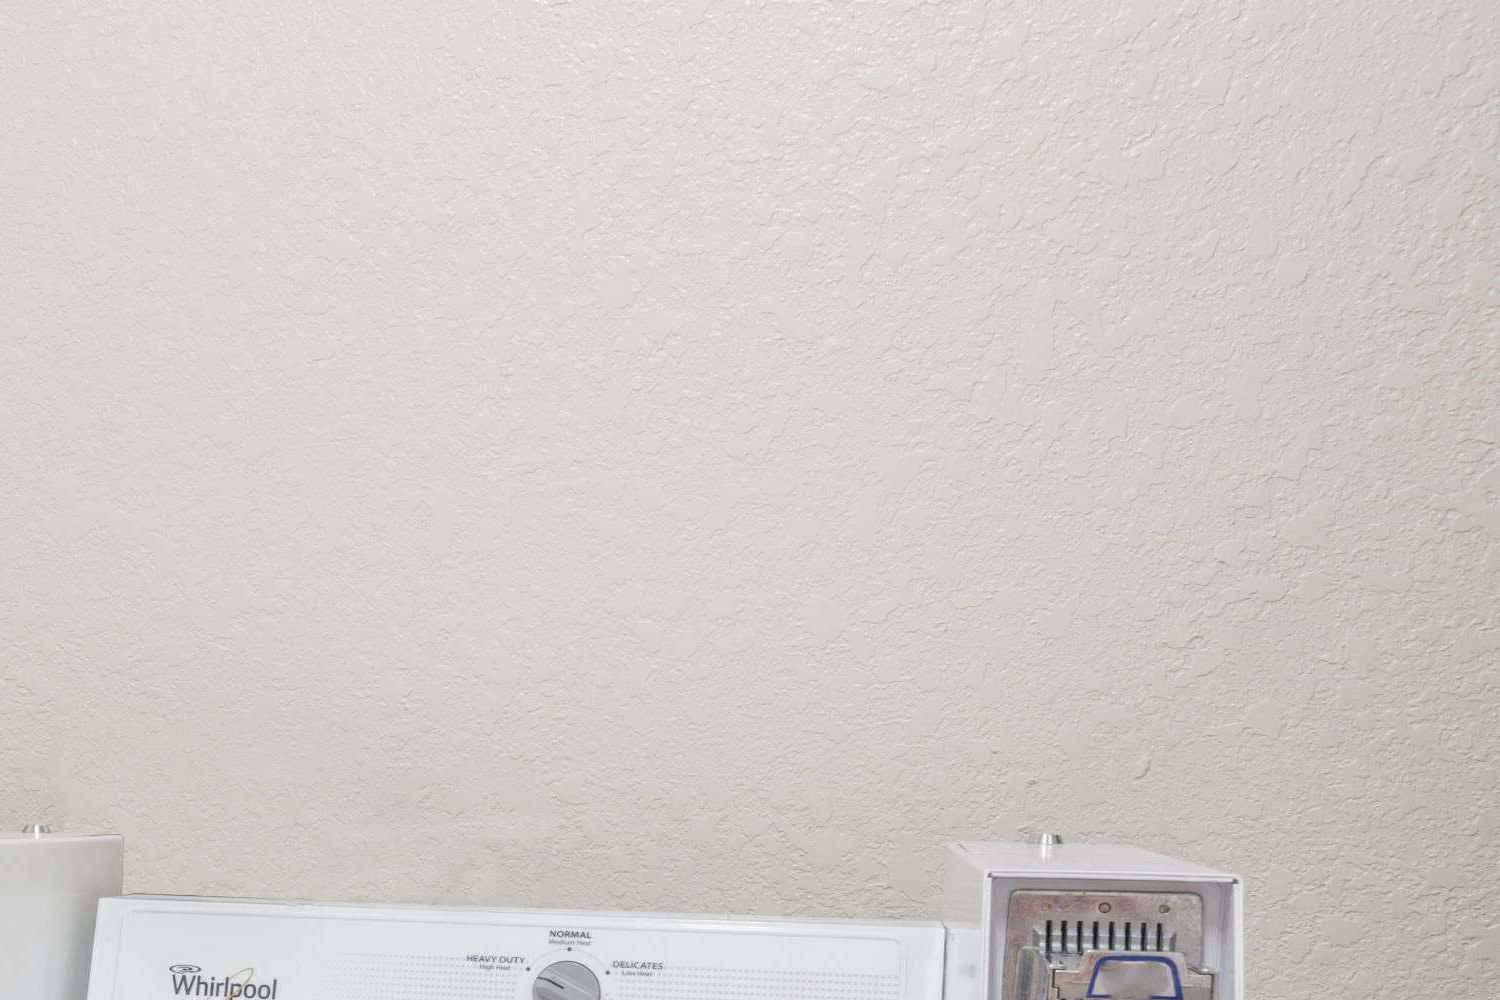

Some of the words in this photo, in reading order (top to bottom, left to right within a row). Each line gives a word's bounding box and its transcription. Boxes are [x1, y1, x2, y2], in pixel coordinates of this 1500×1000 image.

[549, 930, 592, 939] NORMAL
[466, 954, 497, 963] HEAVY
[499, 955, 525, 964] DUTY
[612, 960, 664, 970] DELICATES
